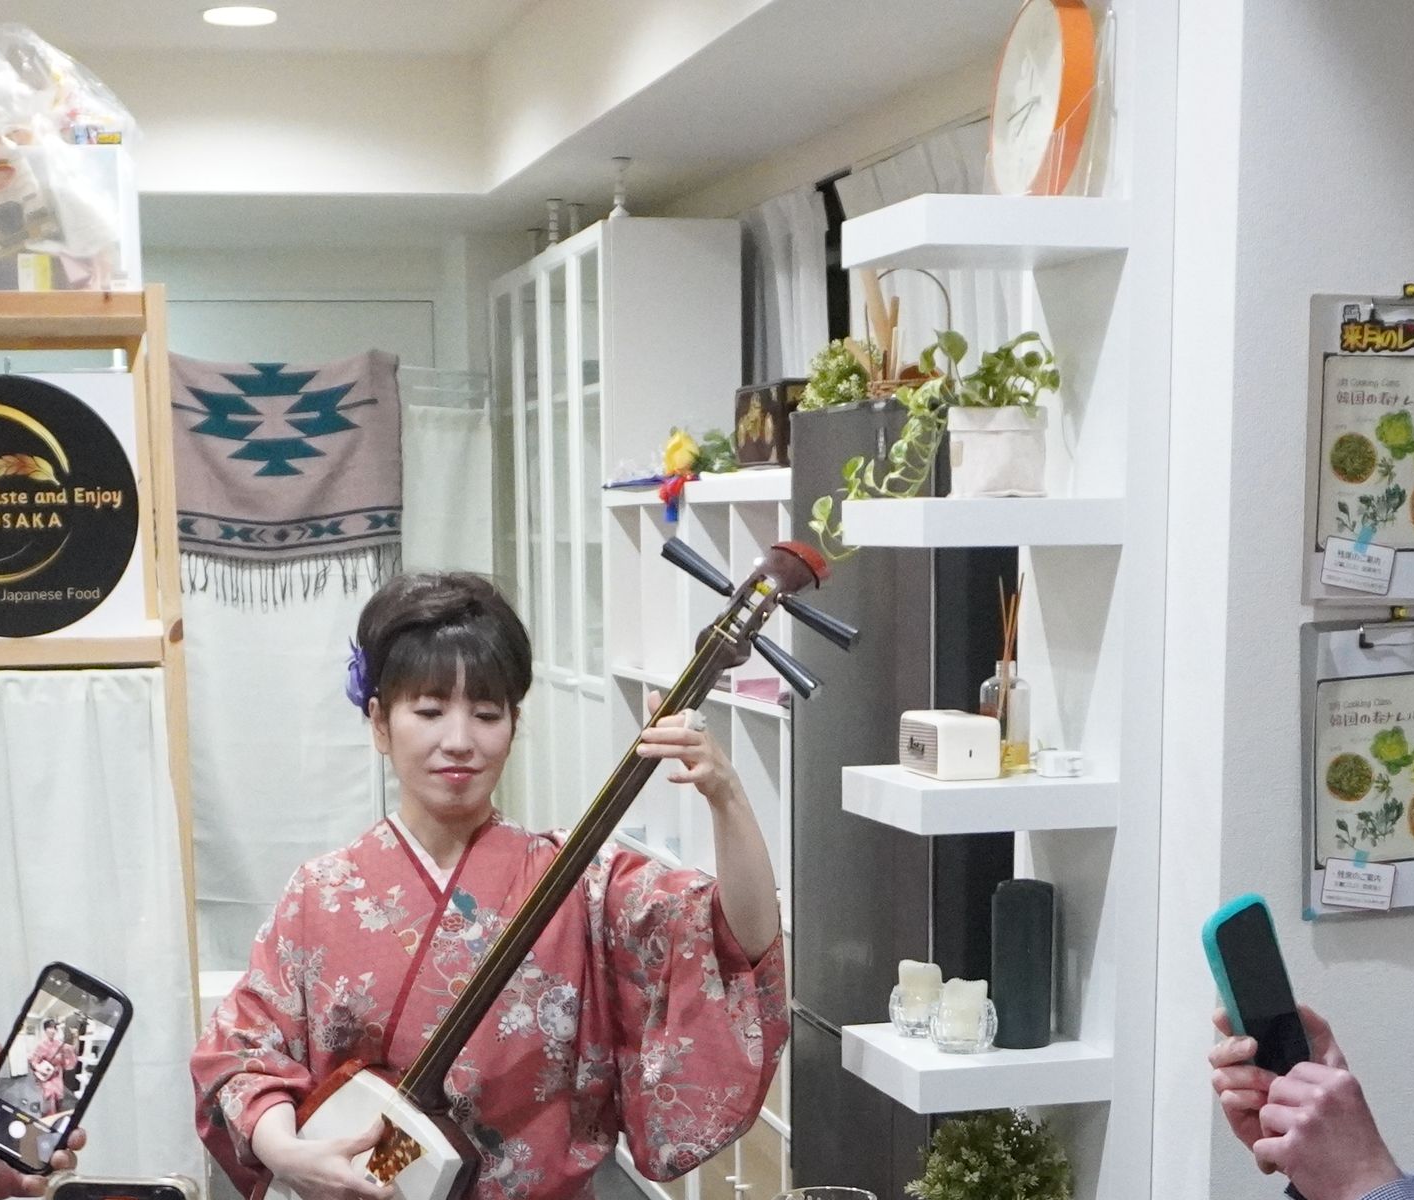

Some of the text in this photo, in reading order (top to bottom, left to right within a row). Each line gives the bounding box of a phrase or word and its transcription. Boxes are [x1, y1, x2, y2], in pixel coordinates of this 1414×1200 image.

[34, 488, 68, 504] and
[73, 486, 123, 510] Enjoy
[0, 588, 63, 603] Japanese
[66, 586, 101, 600] Food
